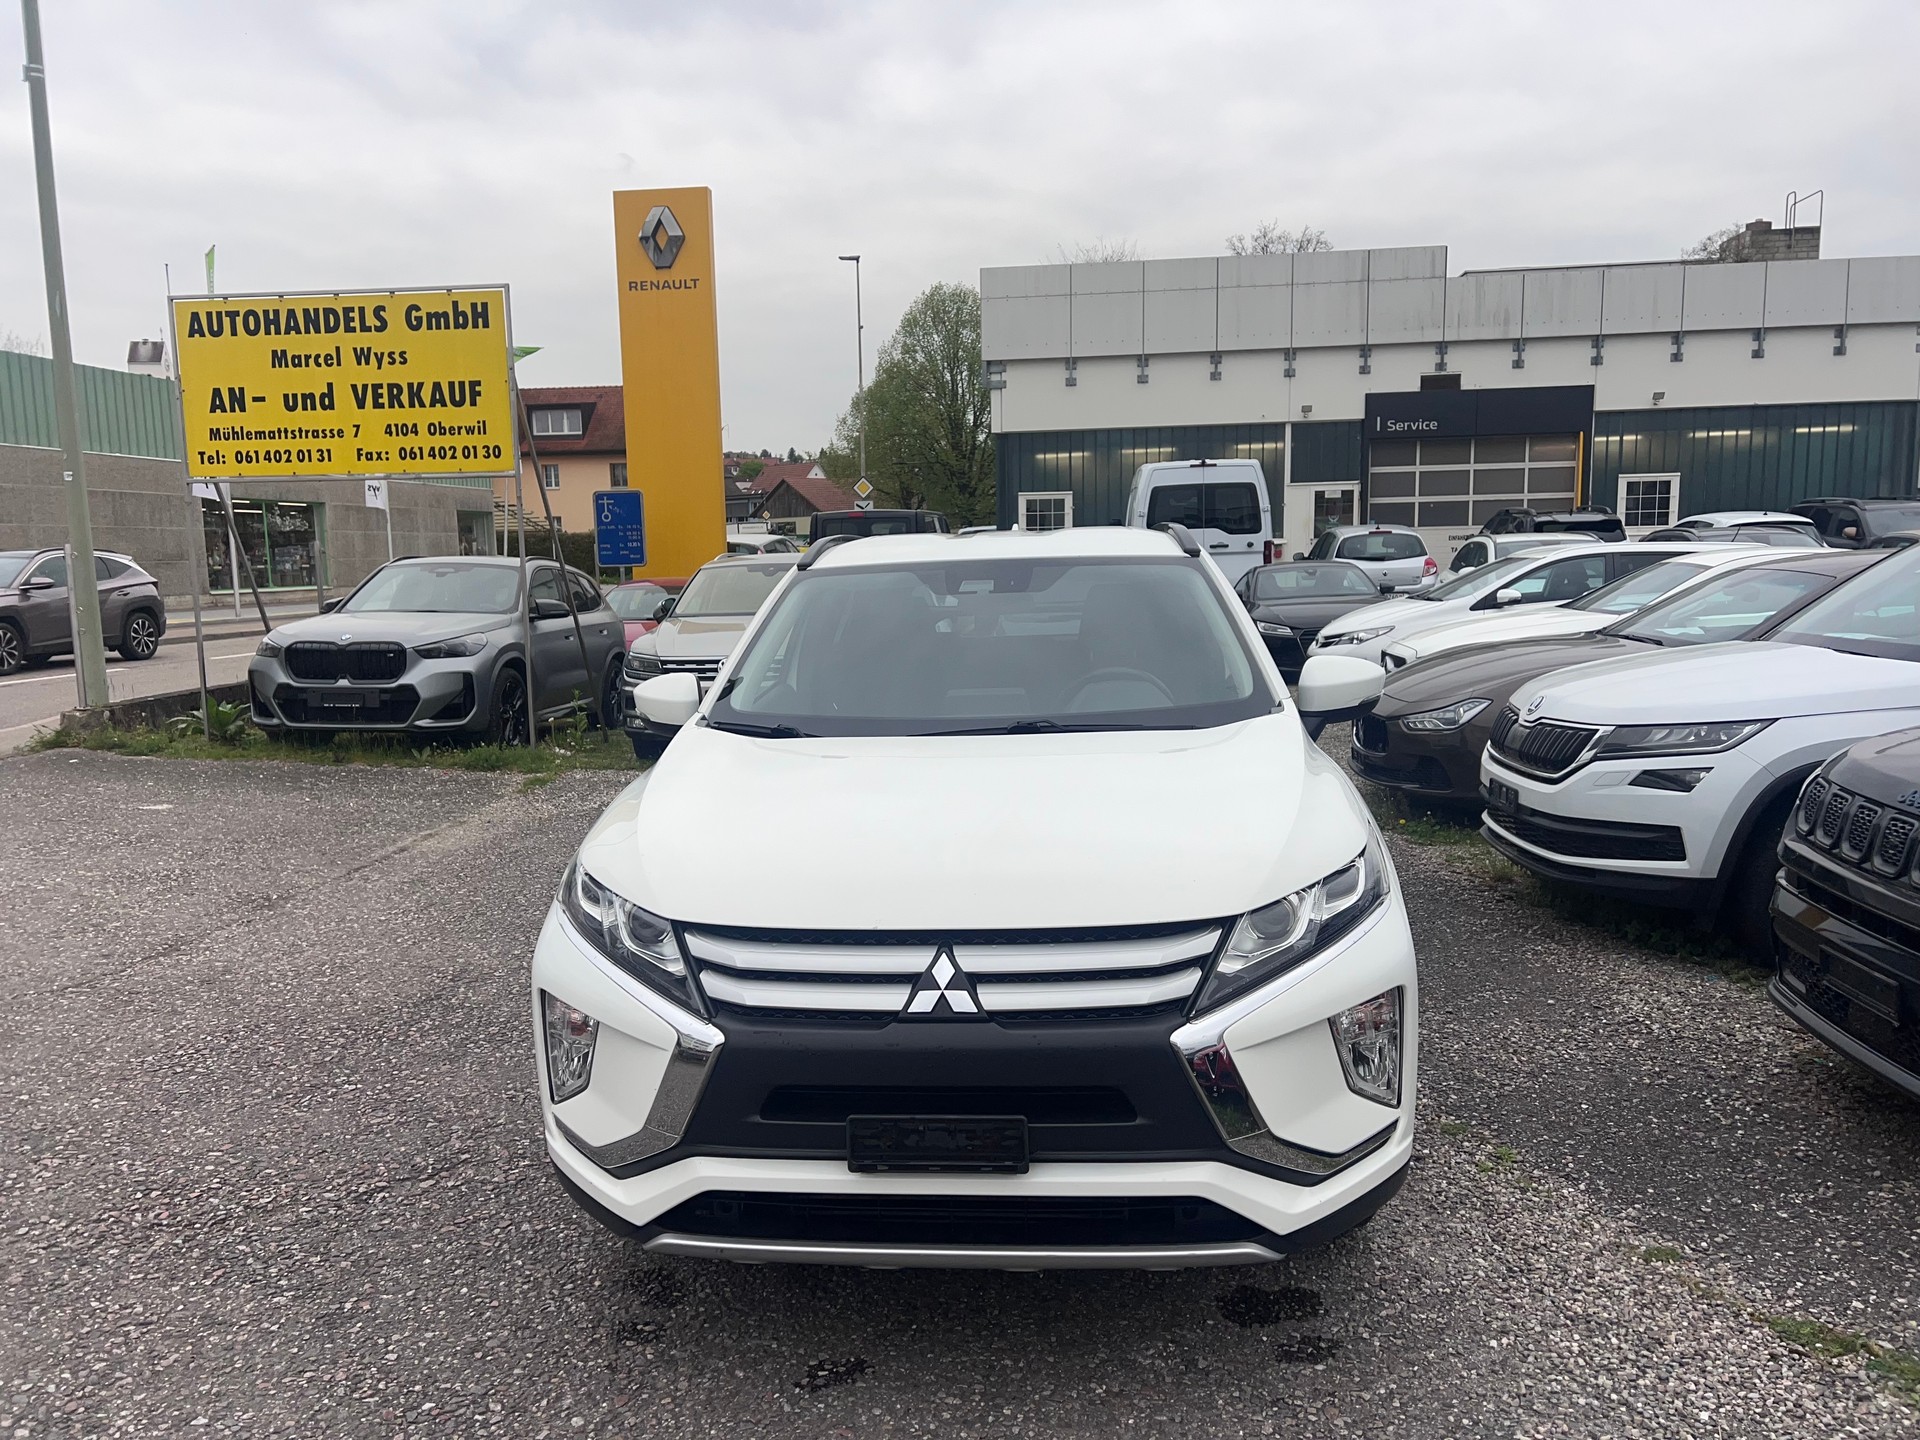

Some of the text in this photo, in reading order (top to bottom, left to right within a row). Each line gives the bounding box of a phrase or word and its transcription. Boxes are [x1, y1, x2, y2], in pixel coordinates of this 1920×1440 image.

[628, 279, 700, 292] RENAULT
[187, 301, 490, 338] AUTOHANDELS GmbH
[271, 346, 408, 371] Marcel Wyss
[282, 382, 336, 412] und
[350, 380, 482, 410] VERKAUF
[209, 420, 487, 441] Mühlemattstrasse 7 4104 Oberwil
[1387, 418, 1438, 431] Service
[198, 450, 227, 465] Tel:
[356, 447, 390, 462] Fax:
